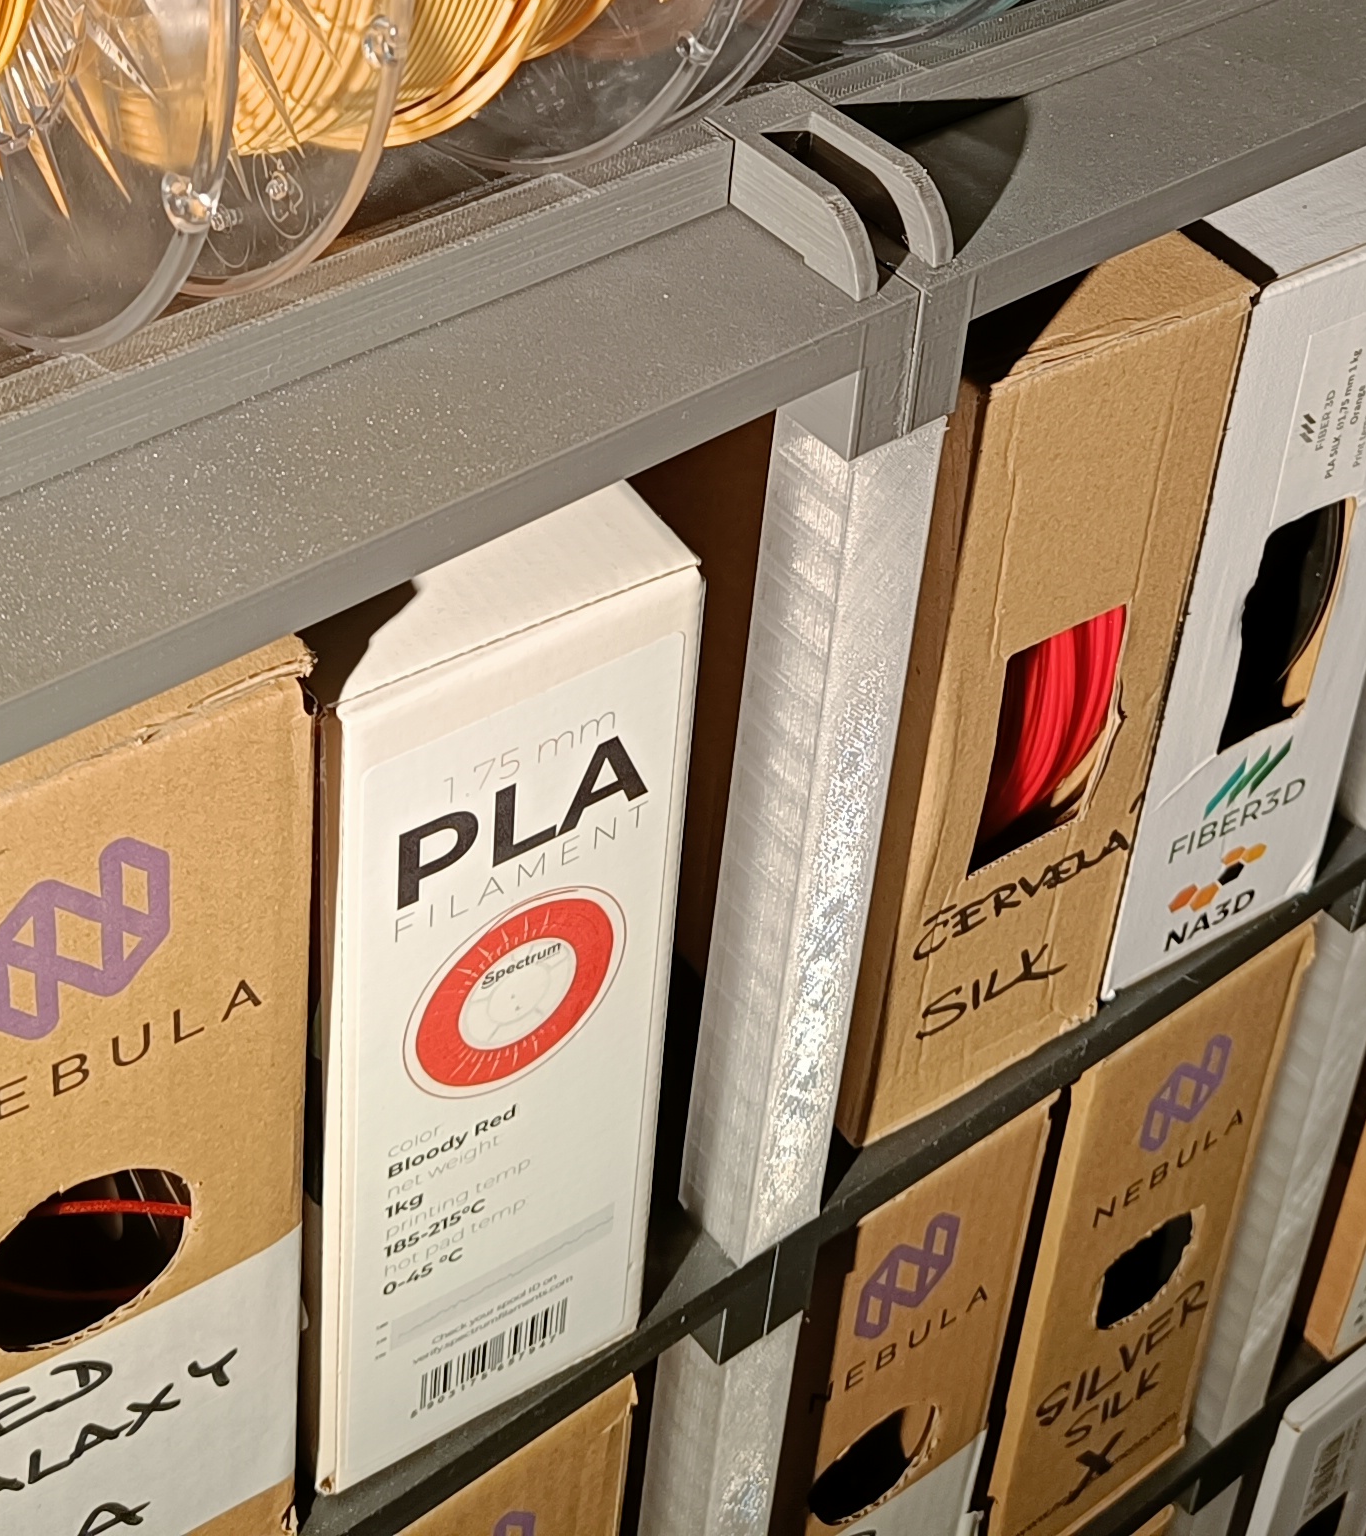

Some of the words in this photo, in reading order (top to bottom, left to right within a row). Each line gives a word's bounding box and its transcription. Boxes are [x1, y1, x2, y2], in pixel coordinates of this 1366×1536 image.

[1349, 384, 1366, 426] Orange
[443, 746, 521, 804] 1.75
[537, 710, 616, 764] mm
[396, 735, 649, 911] PLA
[1168, 778, 1306, 864] FIBER3D
[394, 800, 649, 943] FILAMENT
[1163, 889, 1256, 953] NA3D
[480, 941, 563, 990] Spectrum
[915, 943, 1069, 1041] SILK
[387, 1131, 469, 1179] Bloody
[473, 1102, 519, 1137] Red
[1092, 1108, 1244, 1230] NEBULA
[384, 1192, 425, 1220] 1kg
[385, 1189, 470, 1242] printing
[386, 1173, 422, 1200] net
[382, 1261, 434, 1296] 0-45
[383, 1253, 420, 1279] hot
[424, 1226, 465, 1261] pad
[431, 1322, 468, 1345] Check
[469, 1307, 495, 1328] your
[496, 1288, 527, 1313] spool
[528, 1281, 542, 1295] ID
[542, 1273, 558, 1288] on
[809, 1284, 989, 1414] NEBULA
[1035, 1280, 1209, 1427] SILVER
[1064, 1362, 1162, 1448] SILK
